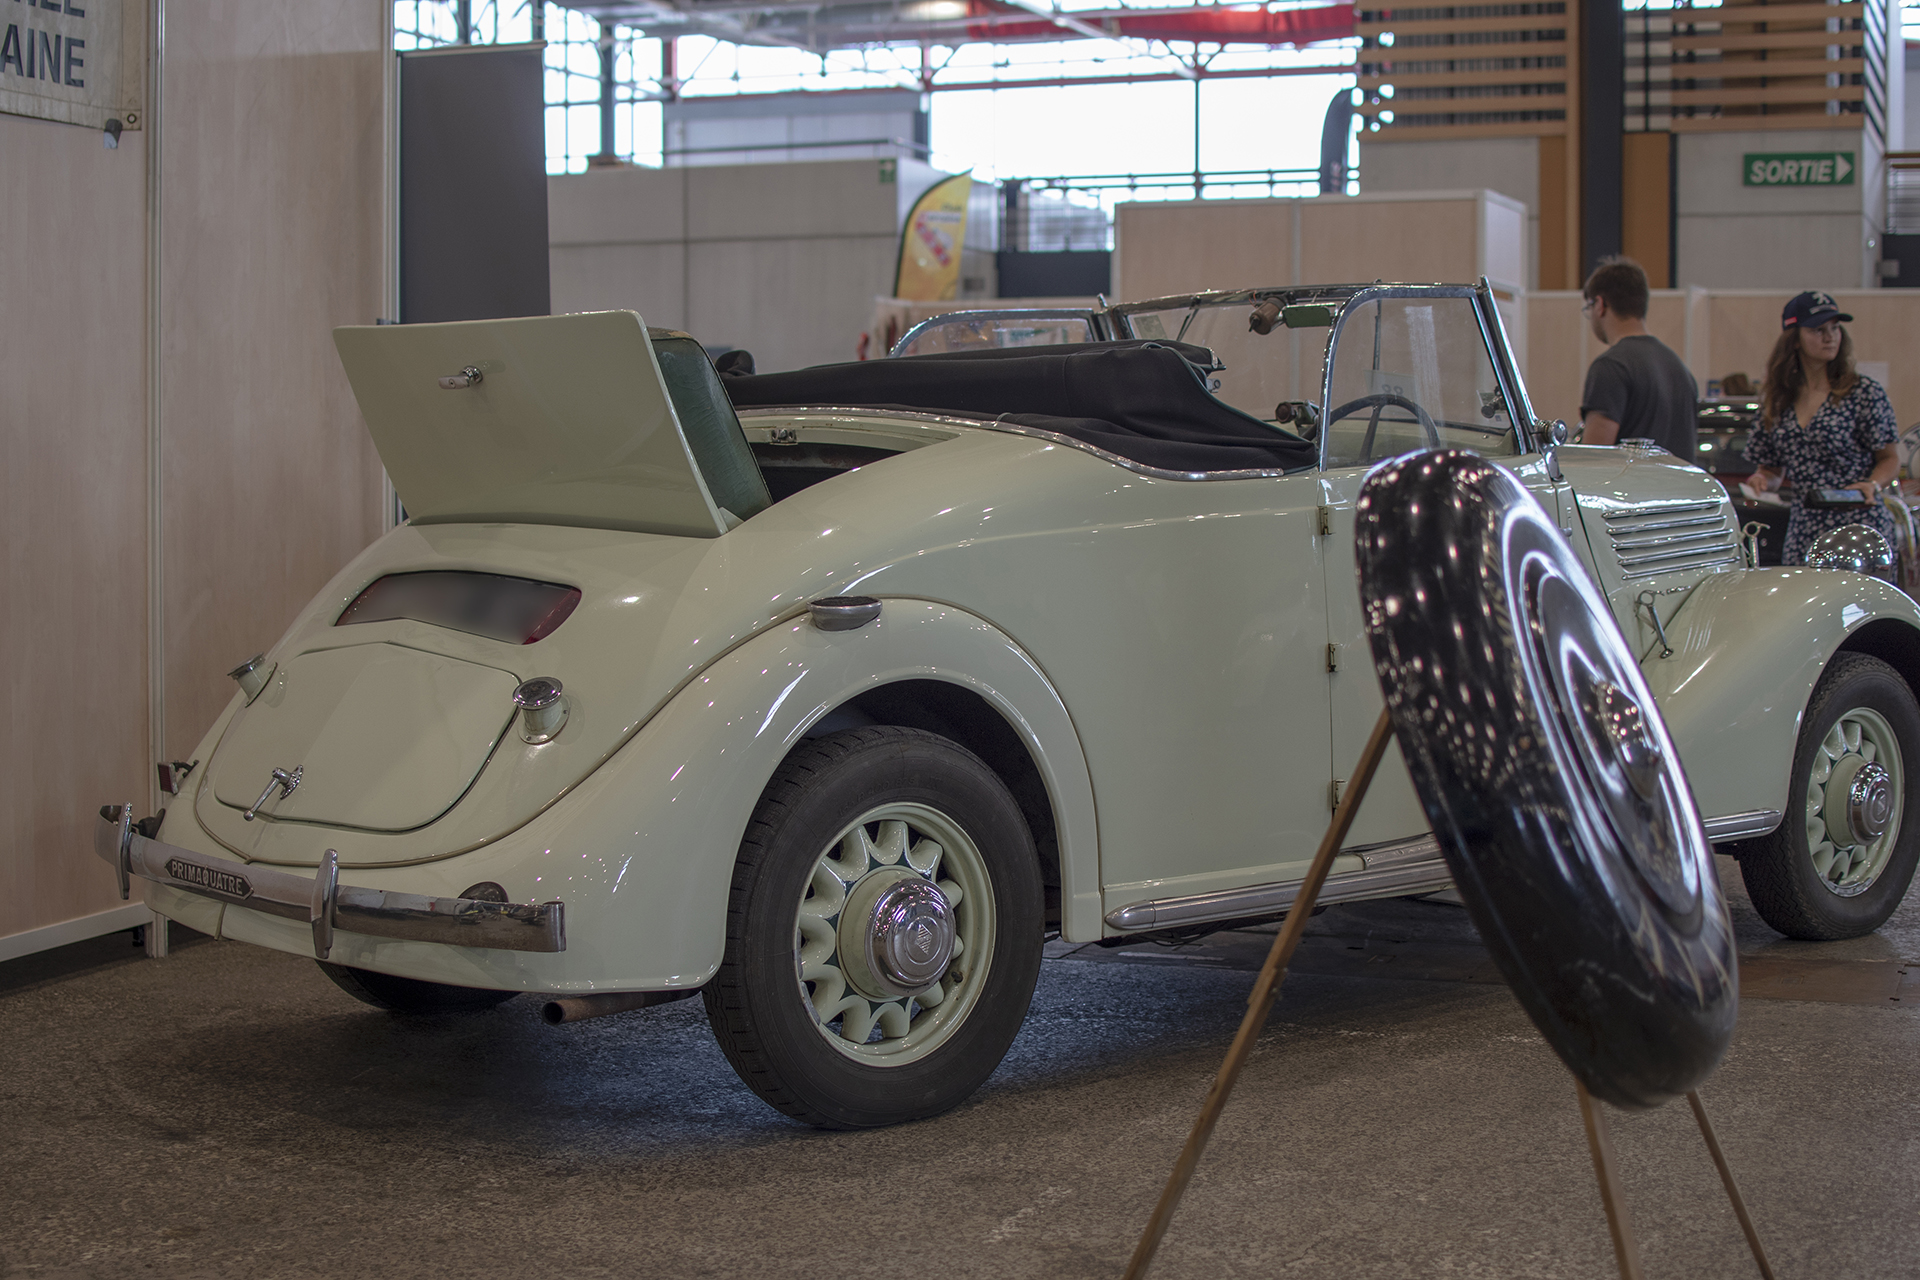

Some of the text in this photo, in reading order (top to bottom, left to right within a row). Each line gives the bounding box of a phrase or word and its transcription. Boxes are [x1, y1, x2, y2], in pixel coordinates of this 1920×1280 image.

[0, 23, 85, 88] AINE
[1750, 159, 1834, 183] SORTIE
[171, 860, 243, 895] PRIMAQUATRE
